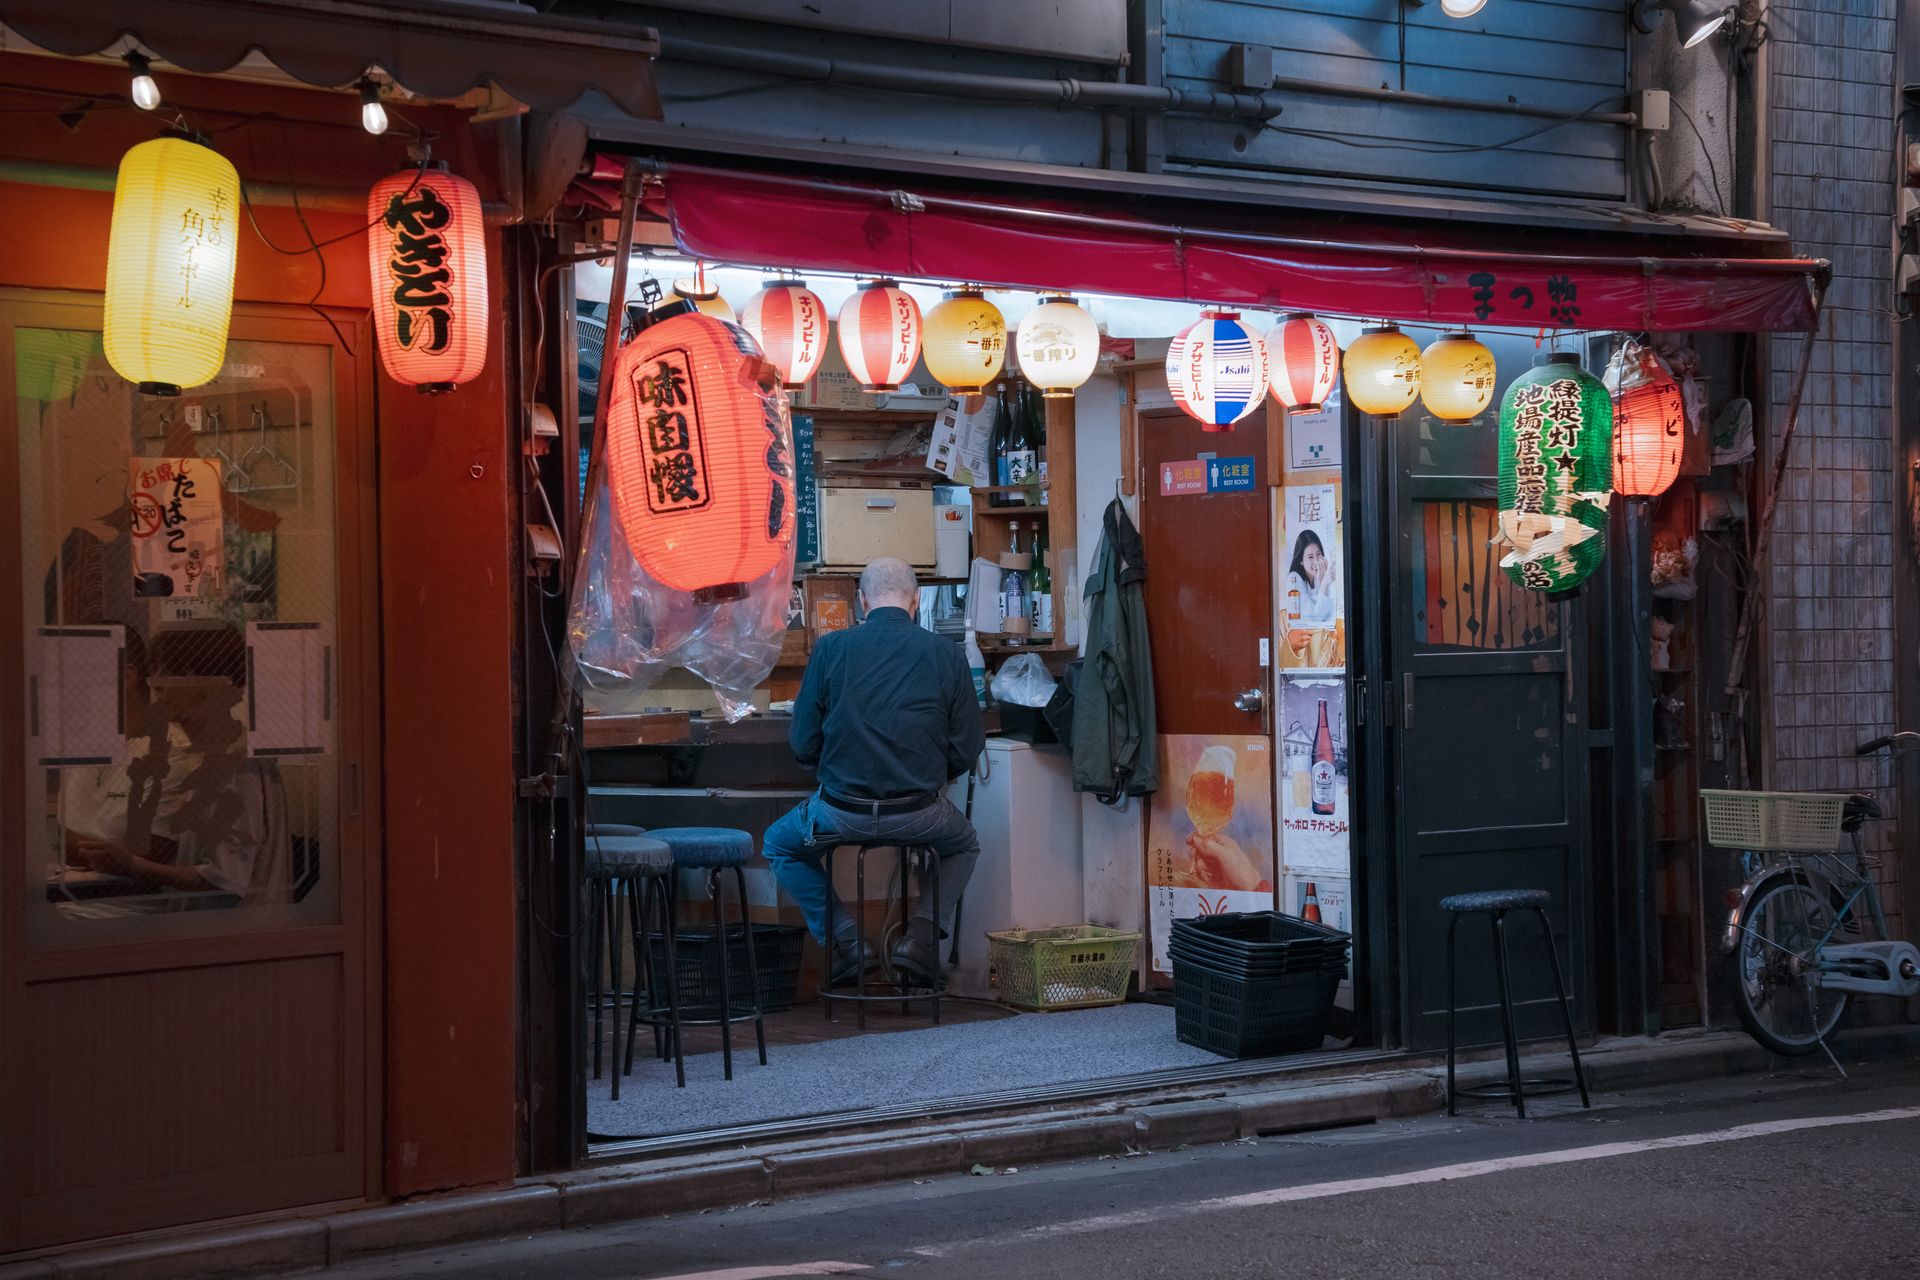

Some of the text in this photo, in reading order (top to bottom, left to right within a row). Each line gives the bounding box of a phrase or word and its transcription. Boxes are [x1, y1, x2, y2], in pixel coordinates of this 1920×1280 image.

[208, 187, 227, 246] 幸せの
[176, 207, 204, 309] 角ハイボール
[384, 185, 453, 353] やきとり
[798, 296, 814, 363] キリンビール
[896, 297, 912, 365] キリンビール
[1022, 348, 1076, 362] 一番搾り
[1316, 325, 1332, 384] キリンビール
[1191, 341, 1205, 401] アサヒビール
[1220, 365, 1250, 375] Asahi
[140, 459, 191, 489] お席で
[1175, 467, 1202, 480] 化粧室
[1222, 464, 1250, 477] 化粧室
[1234, 478, 1249, 486] ROOM
[161, 474, 196, 553] たばこ
[1156, 848, 1166, 907] クラフトビール
